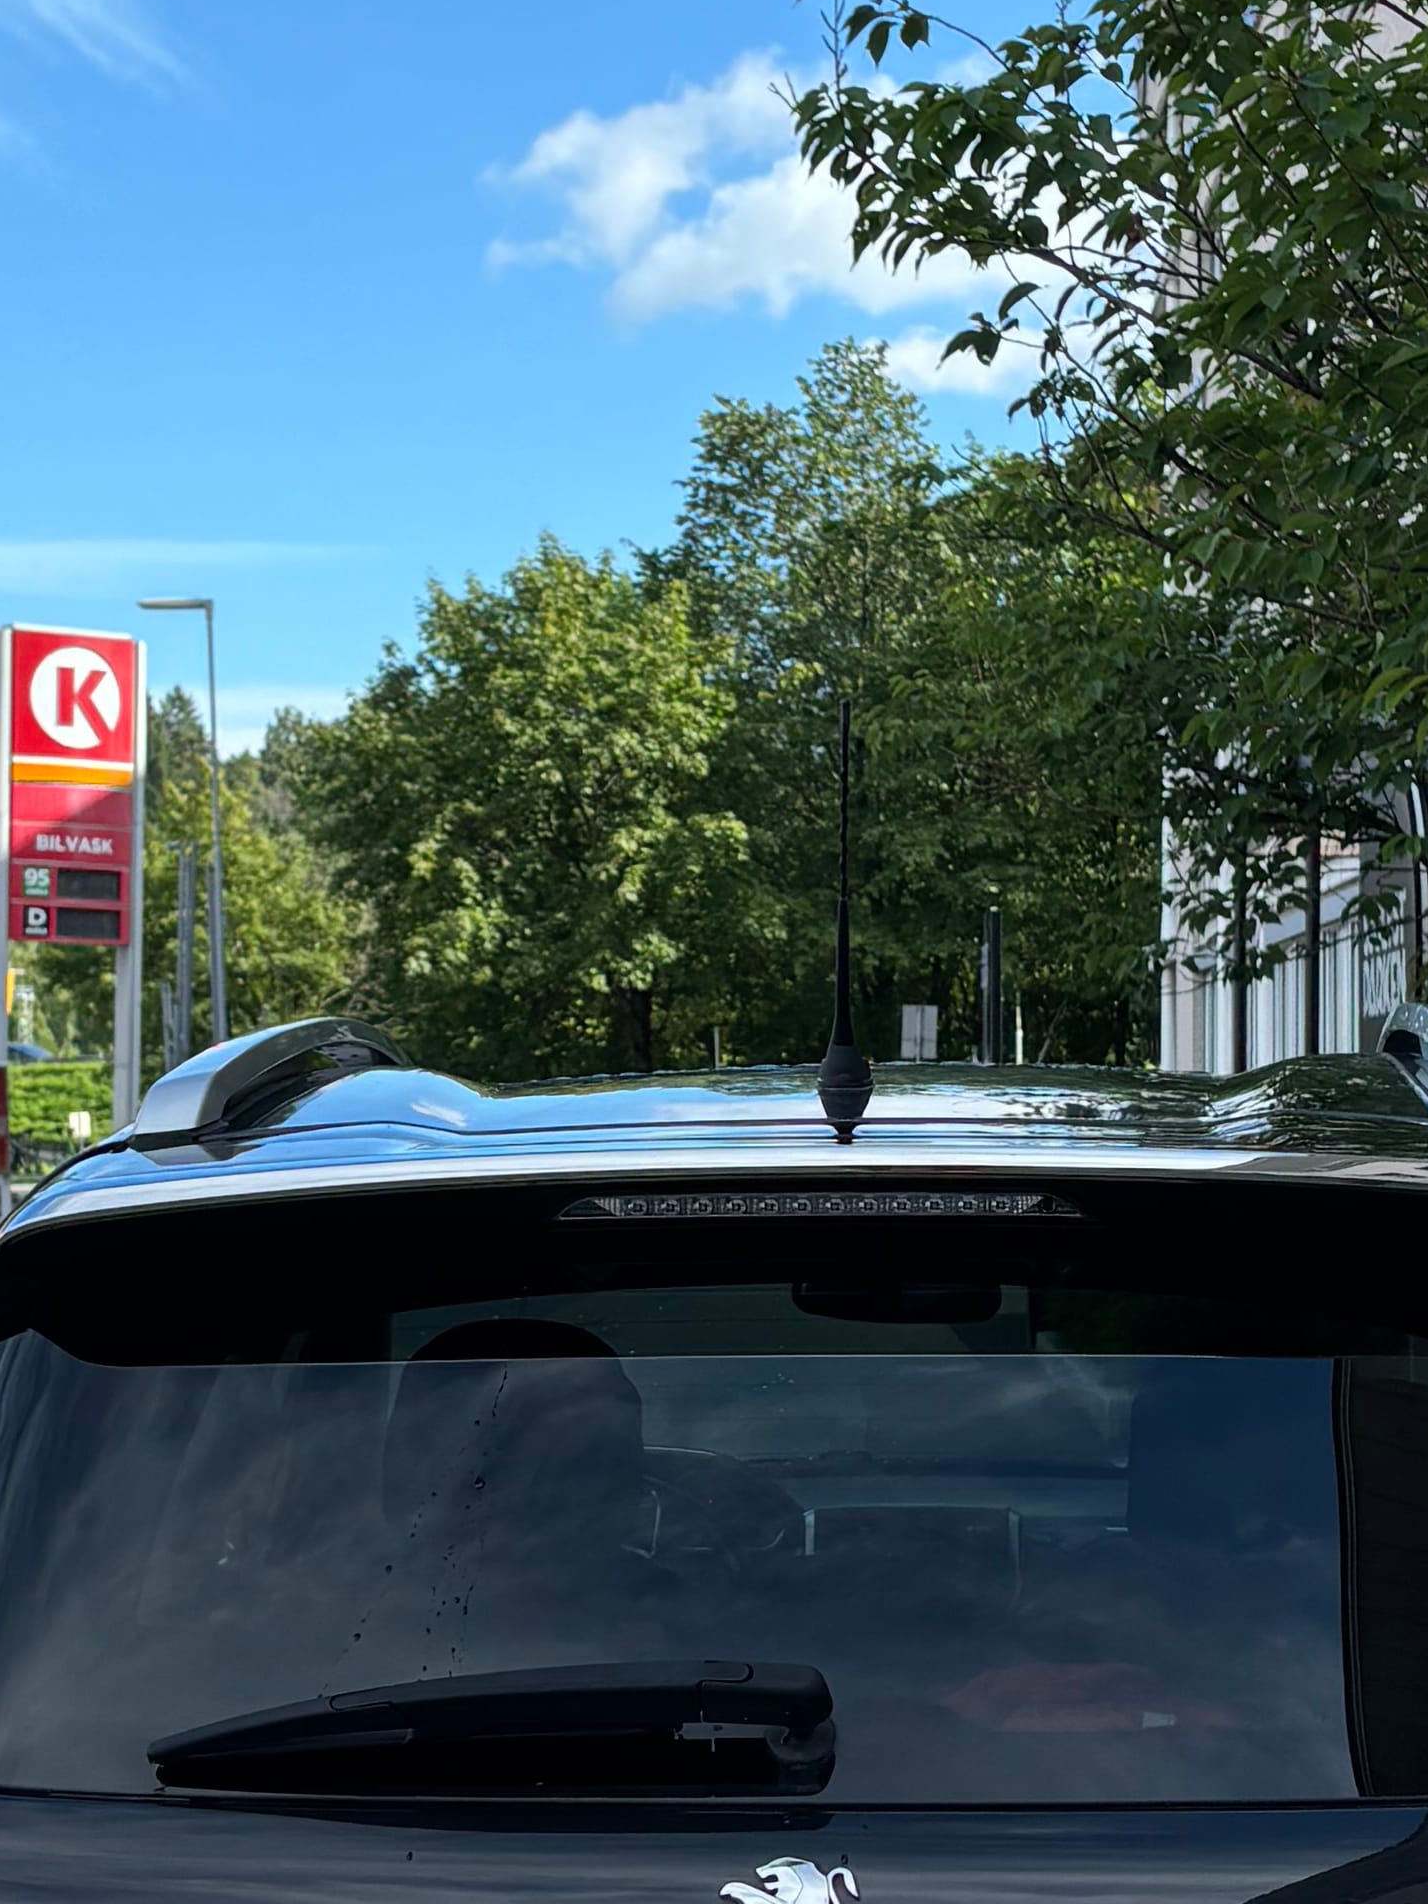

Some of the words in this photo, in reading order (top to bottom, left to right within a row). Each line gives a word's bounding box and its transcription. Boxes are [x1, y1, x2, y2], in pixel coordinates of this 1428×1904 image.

[35, 834, 114, 855] BILVASK
[24, 867, 50, 887] 95
[28, 907, 48, 926] D
